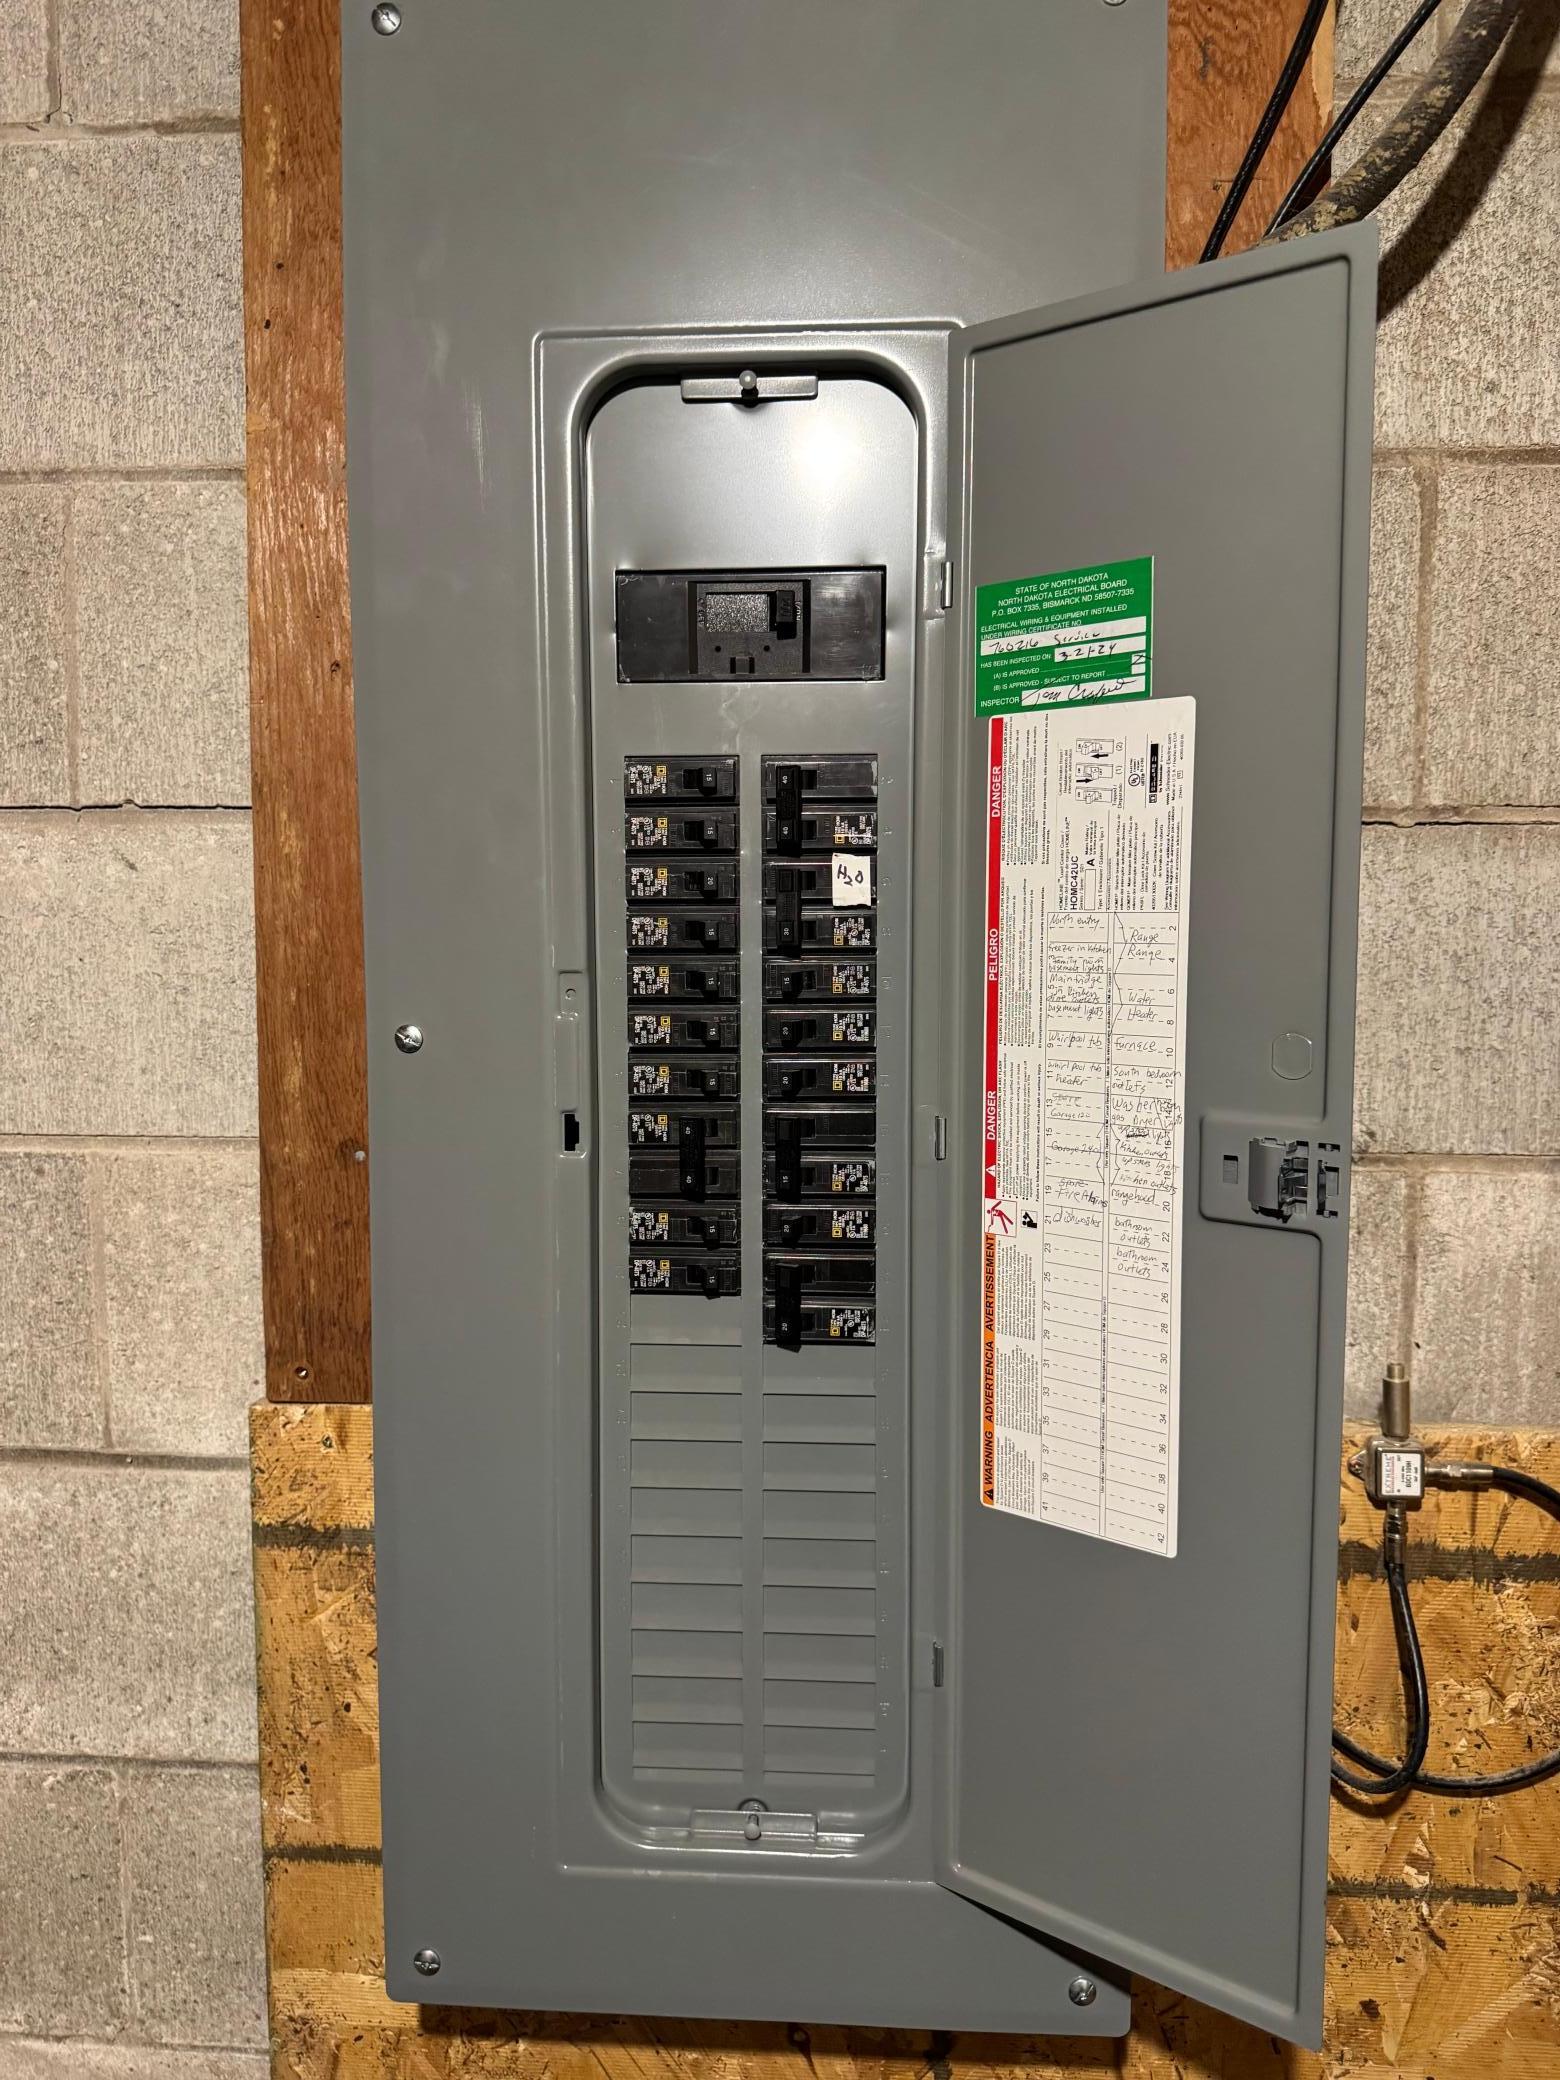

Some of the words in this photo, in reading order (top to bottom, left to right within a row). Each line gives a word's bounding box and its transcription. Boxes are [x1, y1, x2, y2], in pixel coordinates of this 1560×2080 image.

[1016, 586, 1037, 595] STATE
[1051, 579, 1076, 588] NORTH
[1078, 573, 1108, 584] DAKOTA
[998, 598, 1023, 606] NORTH
[1024, 593, 1053, 603] DAKOTA
[1054, 584, 1099, 598] ELECTRICAL
[1101, 579, 1127, 590] BOARD
[992, 609, 1006, 617] P.O.
[1007, 606, 1022, 614] BOX
[1043, 596, 1080, 609] BISMARCK
[1082, 594, 1092, 602] ND
[1095, 588, 1134, 600] 58507-7335
[981, 620, 1018, 632] ELECTRICAL
[1020, 616, 1042, 625] WIRING
[1051, 610, 1089, 621] EQUIPMENT
[1091, 604, 1127, 614] INSTALLED
[980, 631, 1002, 640] UNDER
[1003, 627, 1027, 636] WIRING
[1028, 622, 1070, 633] CERTIFICATE
[993, 658, 1008, 666] BEEN
[1010, 655, 1040, 665] INSPECTED
[1009, 668, 1040, 677] APPROVED
[1009, 680, 1039, 689] APPROVED
[1081, 671, 1105, 679] REPORT
[980, 697, 1019, 707] INSPECTOR
[706, 774, 711, 782] 15
[782, 776, 788, 784] 40
[991, 766, 1001, 818] DANGER
[708, 827, 713, 835] 15
[782, 827, 788, 835] 40
[1086, 858, 1095, 866] A
[708, 877, 713, 885] 20
[1071, 856, 1079, 910] HOMC42UC
[709, 928, 714, 936] 15
[784, 928, 789, 936] 30
[1130, 930, 1158, 947] Range
[989, 928, 998, 981] PELIGRO
[1128, 945, 1161, 966] Range
[708, 977, 713, 985] 15
[784, 977, 790, 985] 15
[1129, 993, 1156, 1004] Water
[1128, 1009, 1158, 1020] Heater
[710, 1028, 715, 1036] 15
[783, 1027, 788, 1036] 20
[1090, 1038, 1102, 1046] tub
[1166, 1048, 1173, 1057] 10
[1047, 1070, 1053, 1079] 11
[1113, 1068, 1139, 1077] South
[782, 1077, 788, 1085] 20
[1166, 1078, 1172, 1088] 12
[1046, 1099, 1053, 1108] 13
[987, 1091, 997, 1140] DANGER
[1046, 1127, 1052, 1137] 15
[1045, 1157, 1052, 1166] 17
[1045, 1185, 1052, 1195] 19
[1162, 1201, 1170, 1212] 20
[1045, 1214, 1052, 1224] 21
[784, 1225, 790, 1233] 20
[1115, 1217, 1152, 1232] bathroom
[1163, 1232, 1169, 1243] 22
[1044, 1243, 1051, 1253] 23
[1117, 1246, 1157, 1262] bathroom
[1162, 1262, 1169, 1273] 24
[709, 1276, 715, 1284] 15
[1044, 1272, 1051, 1282] 25
[985, 1235, 995, 1331] AVERTISSEMENT
[1161, 1292, 1169, 1303] 26
[1043, 1300, 1051, 1311] 27
[1161, 1323, 1168, 1334] 28
[1043, 1329, 1051, 1340] 29
[1043, 1358, 1050, 1368] 31
[1160, 1353, 1167, 1364] 30
[985, 1340, 995, 1422] ADVERTENCIA
[1043, 1386, 1050, 1397] 33
[1160, 1384, 1167, 1394] 32
[1043, 1415, 1050, 1425] 35
[1160, 1414, 1167, 1424] 34
[1043, 1444, 1050, 1454] 37
[1159, 1443, 1166, 1454] 36
[985, 1431, 994, 1485] WARNING
[1043, 1472, 1050, 1482] 39
[1159, 1474, 1166, 1484] 38
[1042, 1500, 1049, 1511] 41
[1158, 1503, 1165, 1514] 40
[1157, 1532, 1165, 1544] 42
